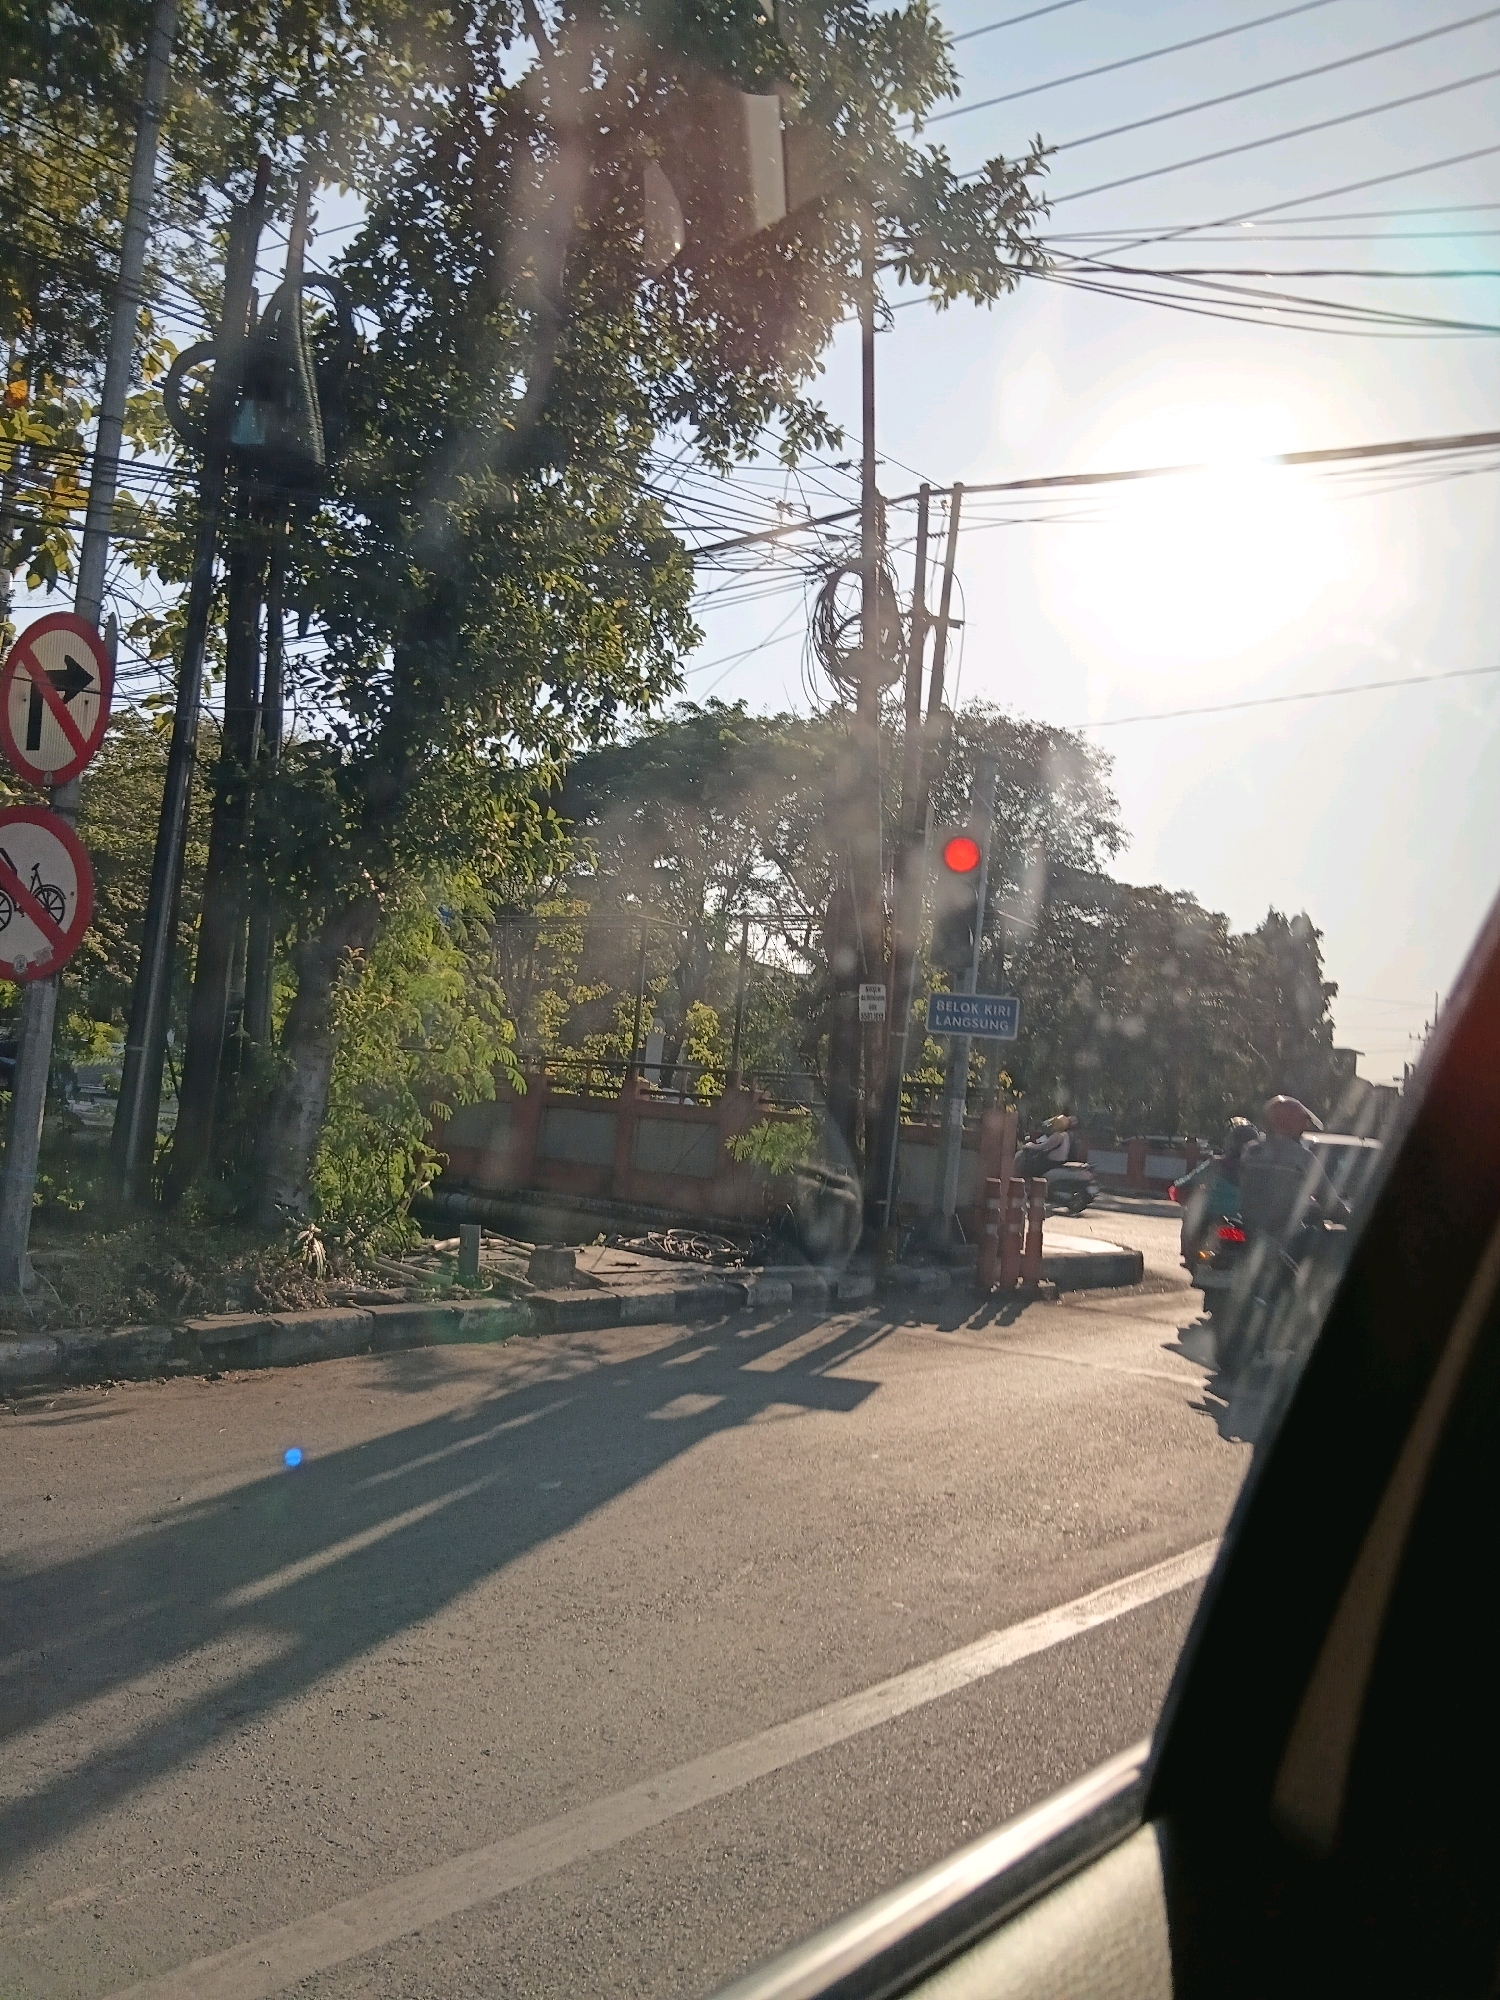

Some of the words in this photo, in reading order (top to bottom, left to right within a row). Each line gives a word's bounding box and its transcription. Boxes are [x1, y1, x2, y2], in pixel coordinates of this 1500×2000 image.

[936, 1000, 979, 1014] BELOK
[984, 1004, 1011, 1017] KIRI
[935, 1015, 1009, 1031] LANGSUNG
